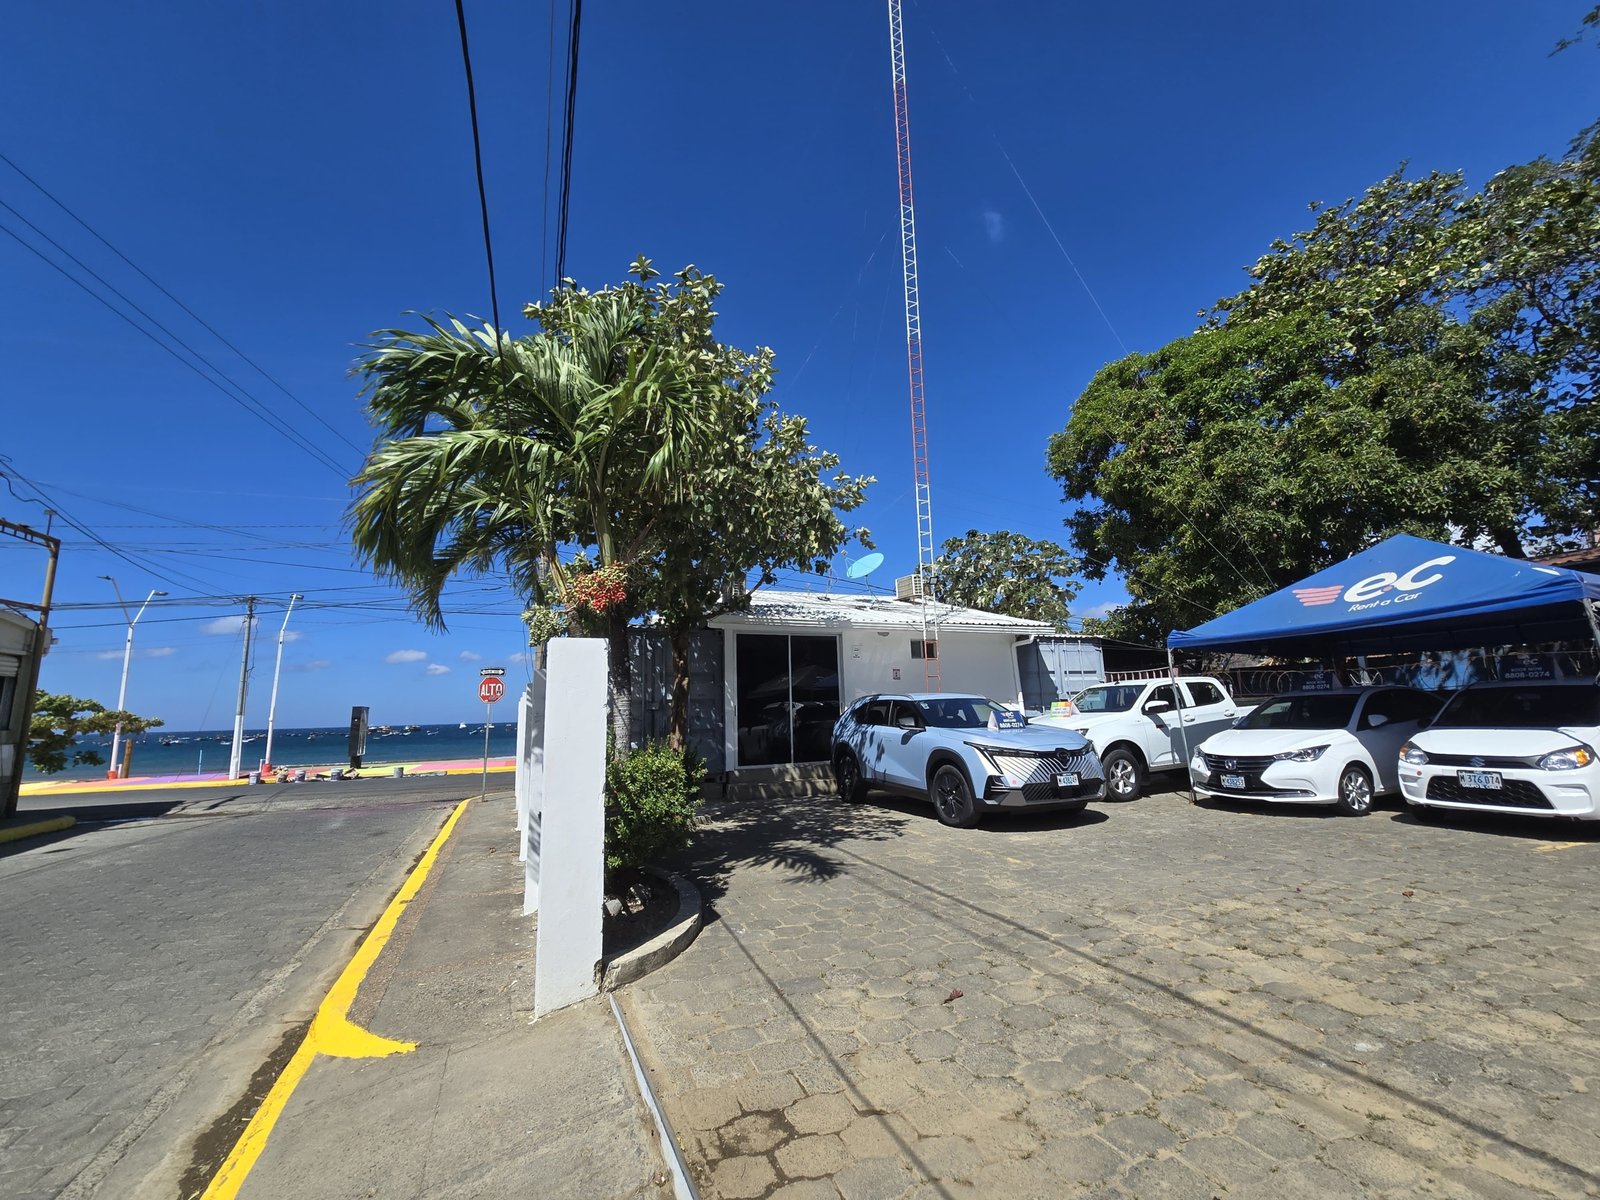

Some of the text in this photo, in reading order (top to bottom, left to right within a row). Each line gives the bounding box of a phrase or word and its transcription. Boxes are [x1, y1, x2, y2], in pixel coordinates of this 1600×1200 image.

[1348, 599, 1380, 612] Rent
[1394, 592, 1422, 603] Car
[1504, 671, 1550, 679] 8808-0274
[480, 683, 503, 697] ALTO
[1460, 773, 1466, 783] M
